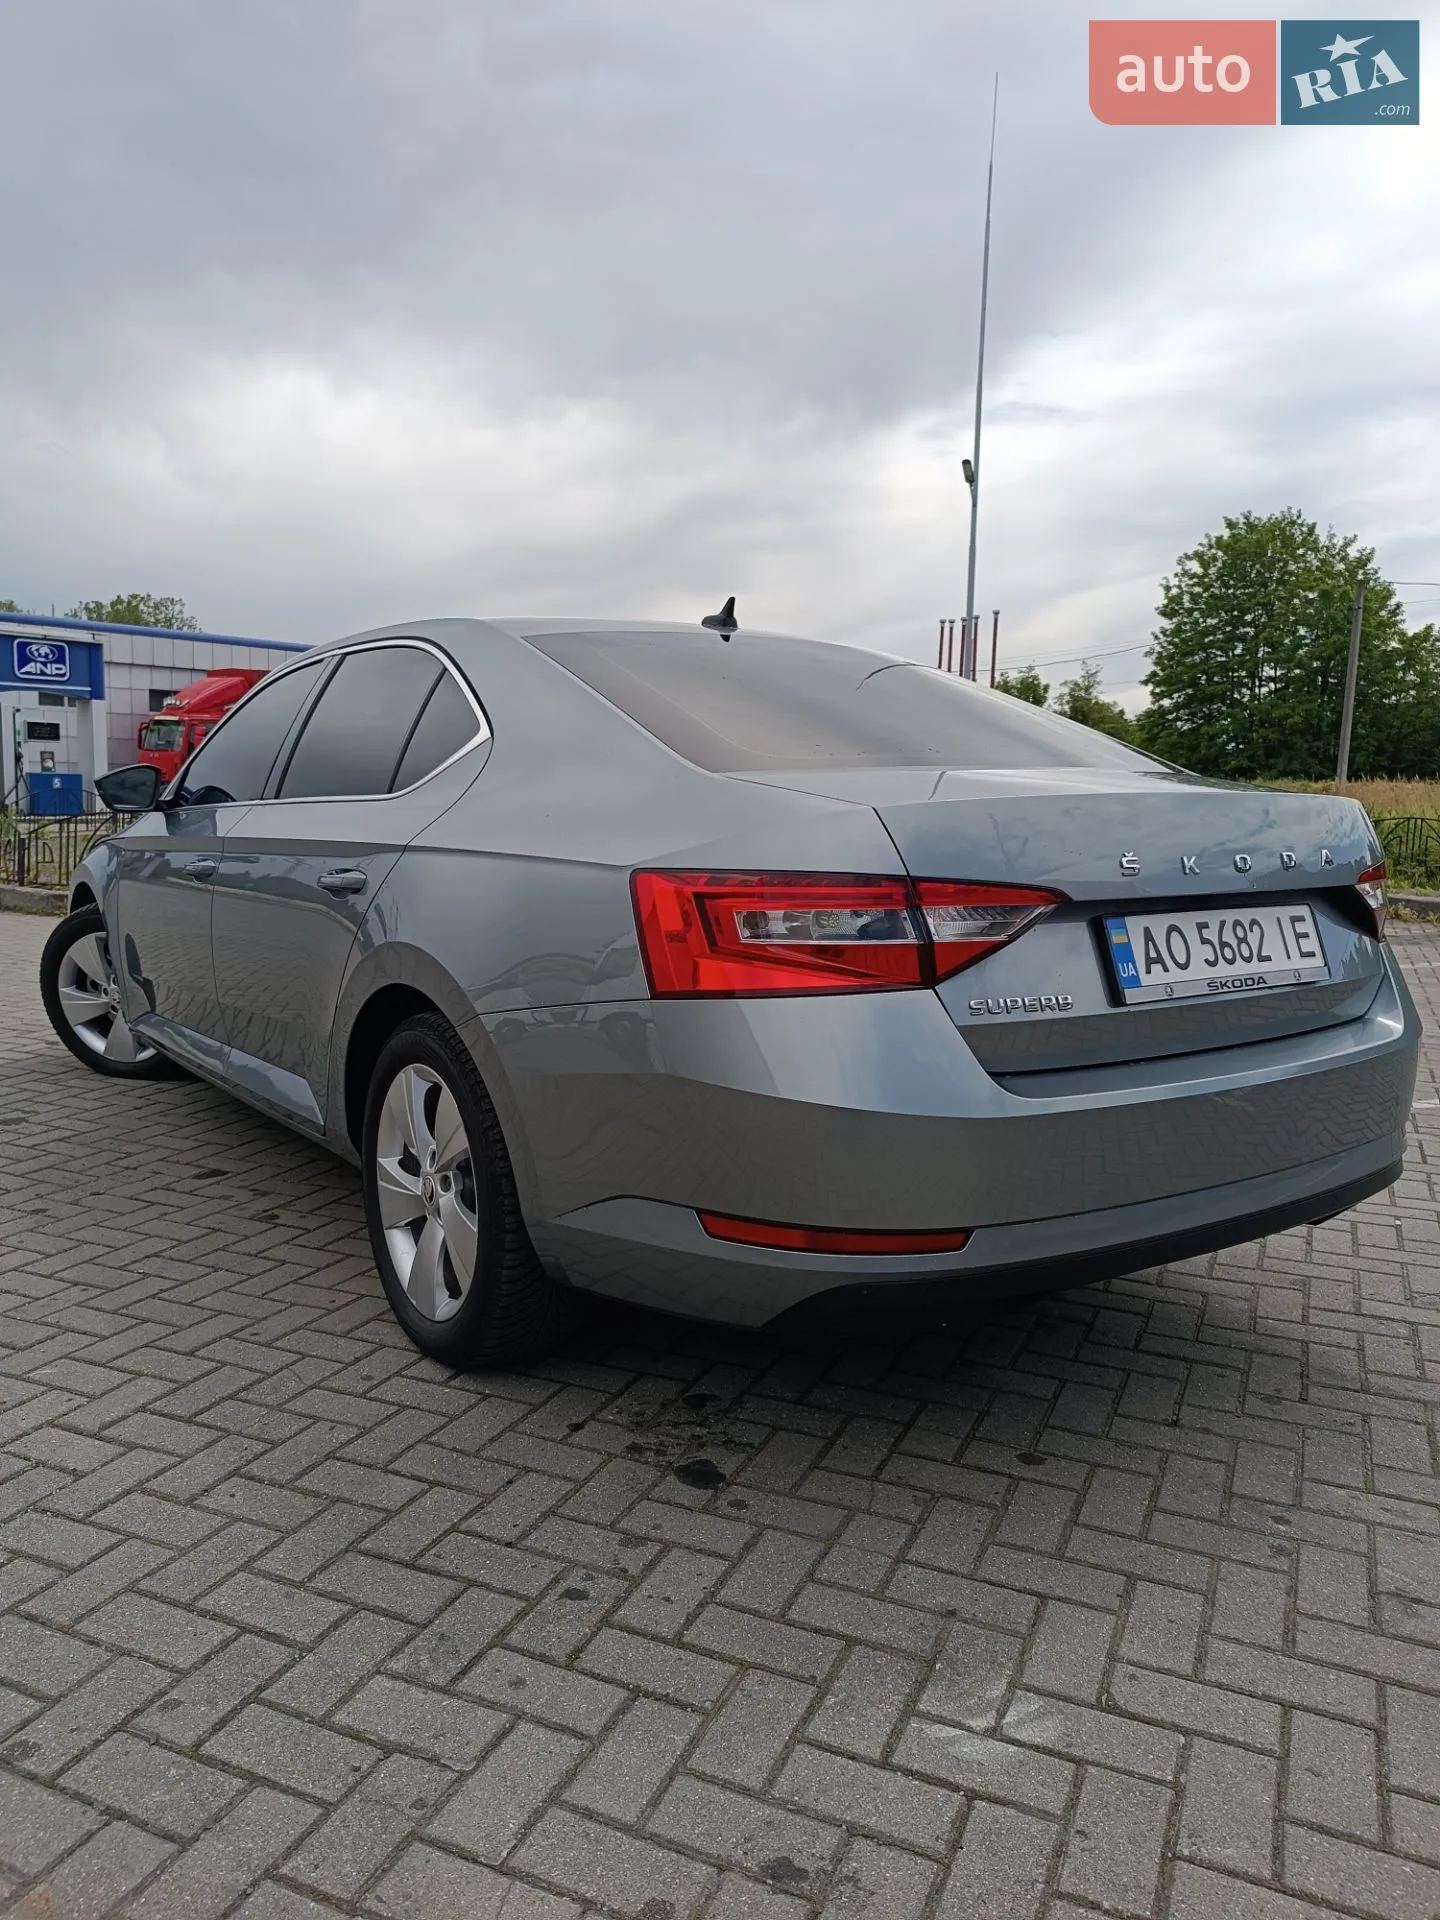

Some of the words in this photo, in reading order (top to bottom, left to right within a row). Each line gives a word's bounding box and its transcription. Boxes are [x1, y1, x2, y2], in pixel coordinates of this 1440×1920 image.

[18, 662, 67, 675] ANP
[53, 778, 61, 788] 5
[1120, 849, 1334, 877] ŠKODA
[1143, 923, 1191, 975] AO
[1196, 917, 1272, 968] 5682
[1278, 914, 1316, 960] IE
[1119, 962, 1137, 978] UA
[1207, 975, 1269, 992] ŠKODA
[968, 994, 1074, 1017] SUPERB
